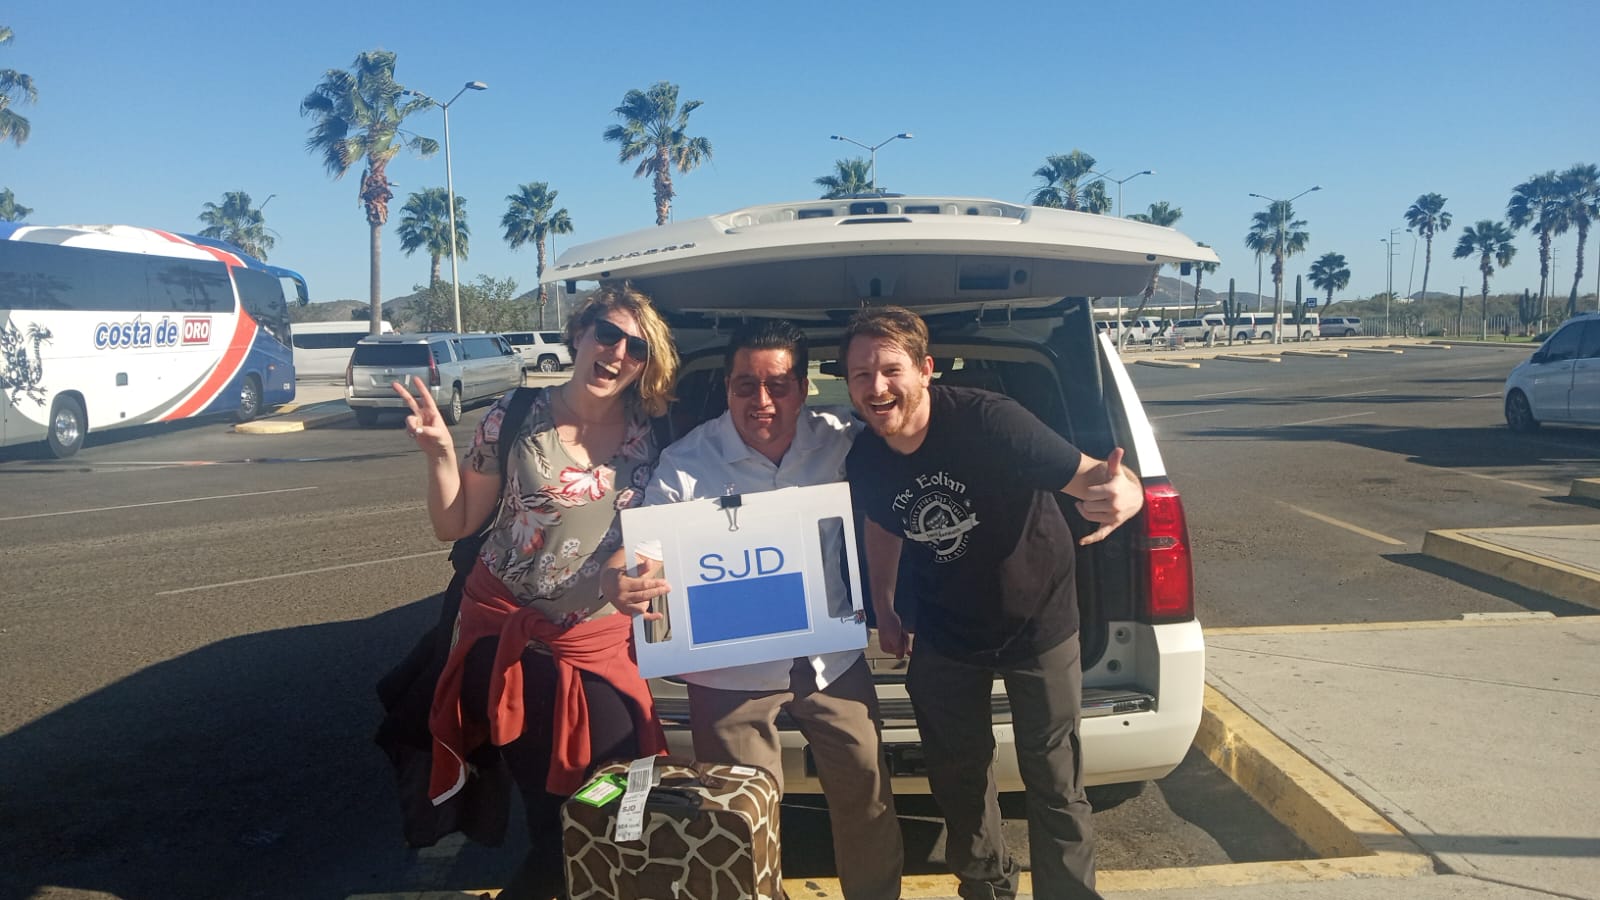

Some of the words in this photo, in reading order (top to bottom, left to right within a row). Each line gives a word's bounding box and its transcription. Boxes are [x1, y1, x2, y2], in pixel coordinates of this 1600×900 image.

[95, 319, 151, 347] costa
[156, 318, 178, 344] de
[184, 321, 209, 339] ORO
[892, 489, 914, 512] The
[915, 471, 967, 494] Eolian
[699, 546, 785, 582] SJD
